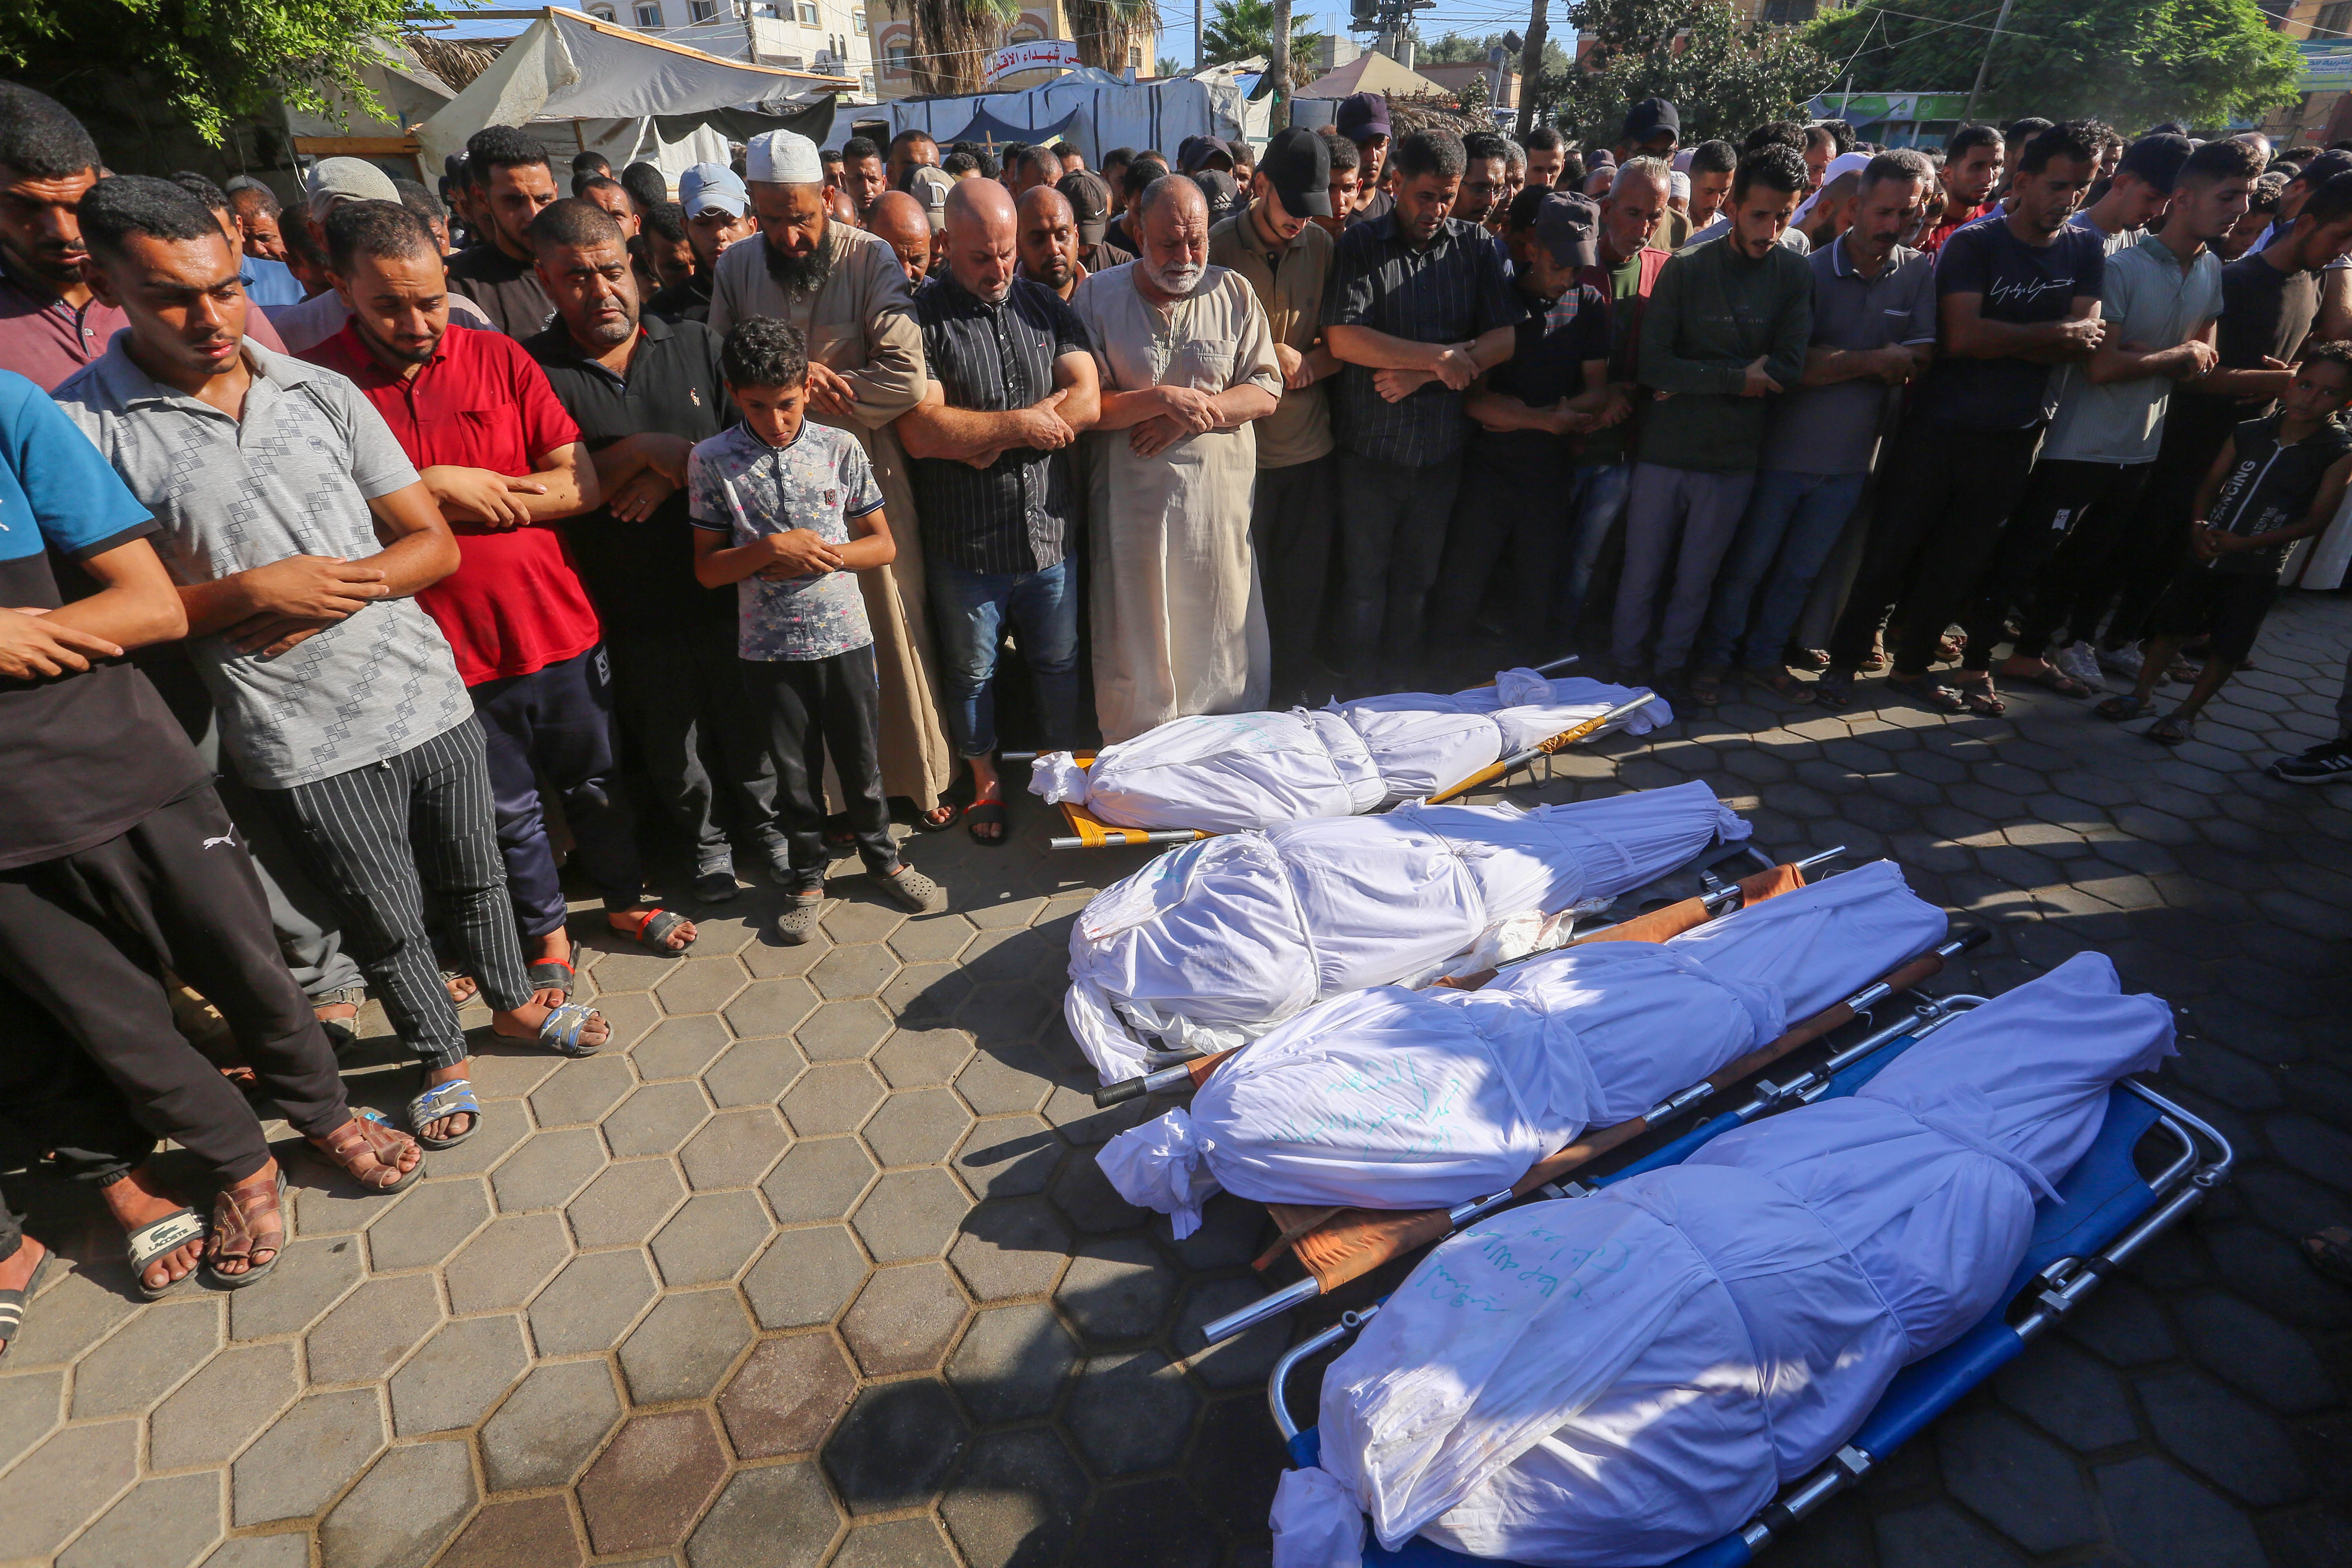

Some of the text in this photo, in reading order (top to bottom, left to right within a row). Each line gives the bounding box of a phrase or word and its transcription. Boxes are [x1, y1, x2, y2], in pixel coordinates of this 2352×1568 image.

[1023, 46, 1060, 63] شهداء
[927, 182, 949, 207] D
[1212, 202, 1235, 211] adidas
[2206, 460, 2256, 530] STANCING
[147, 1227, 189, 1252] LACOSTE
